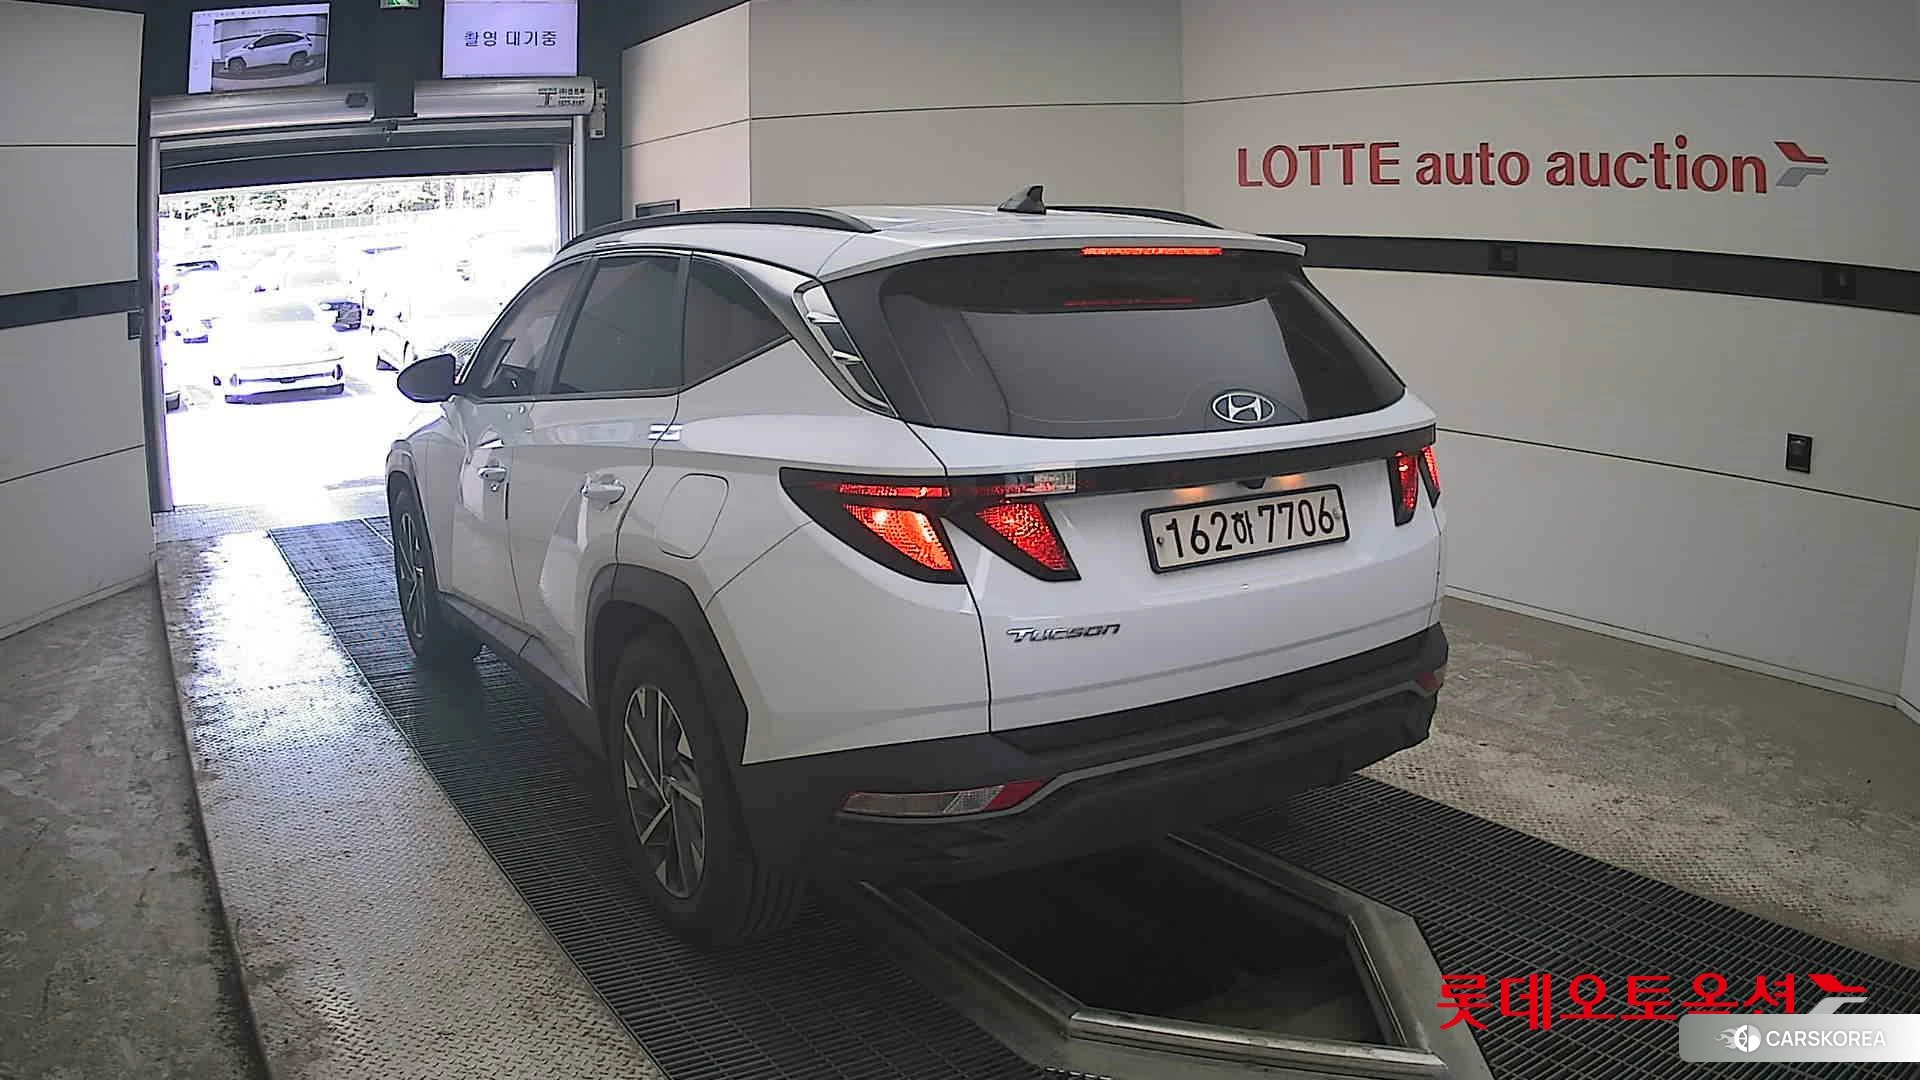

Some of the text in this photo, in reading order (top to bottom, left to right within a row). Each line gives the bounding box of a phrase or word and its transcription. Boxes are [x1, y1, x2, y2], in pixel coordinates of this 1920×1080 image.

[506, 31, 557, 47] 대기중
[1238, 135, 1768, 193] LOTTE auto auction
